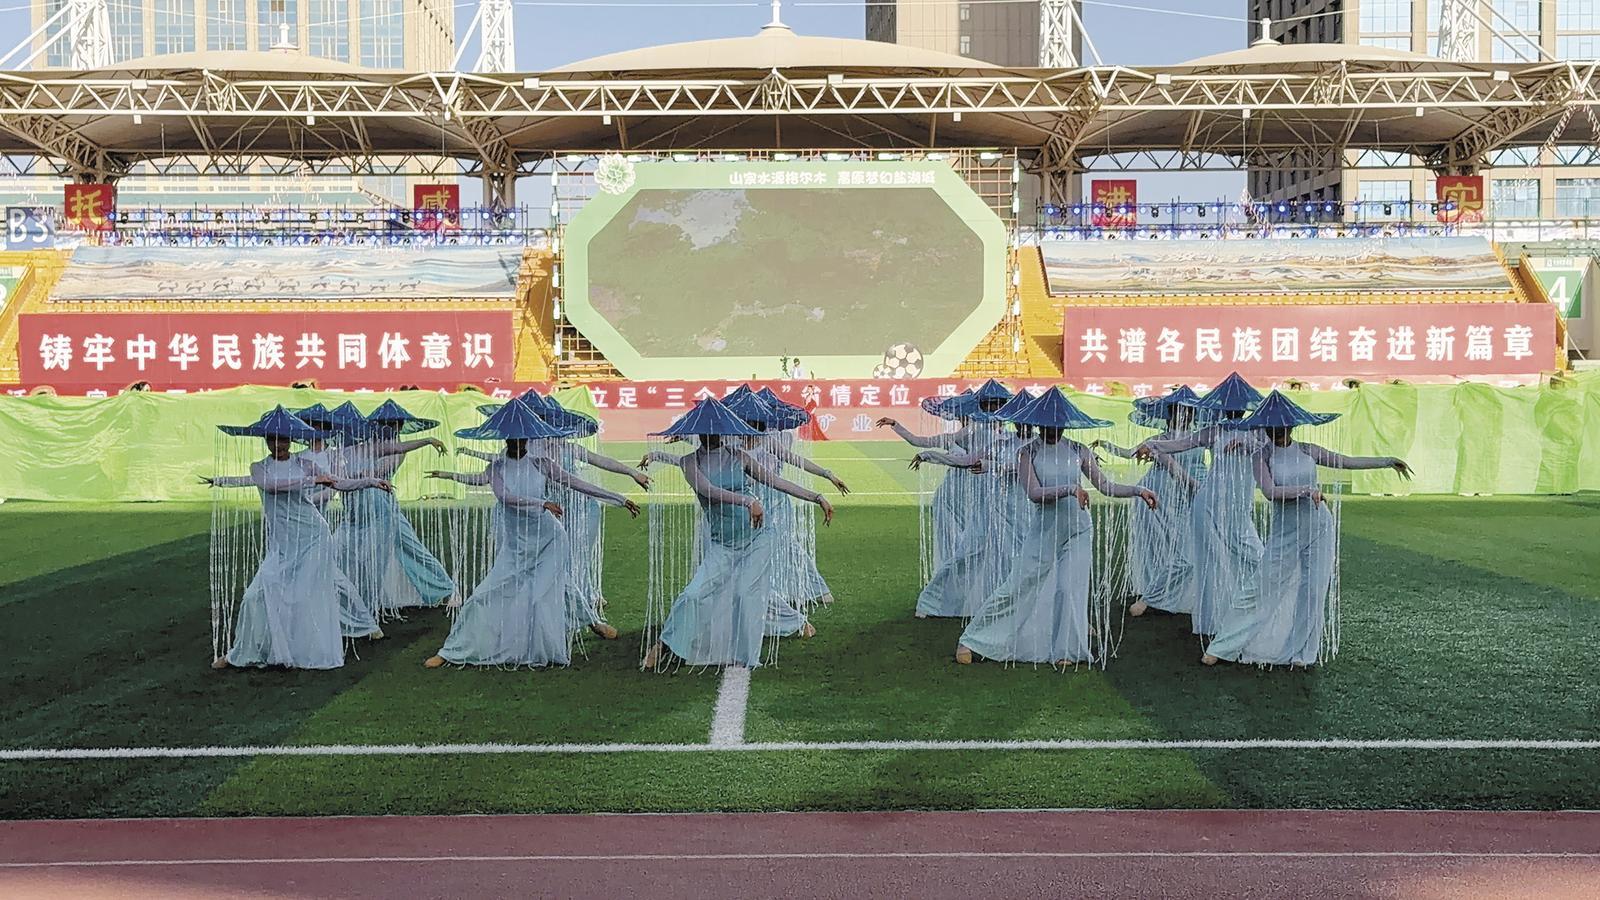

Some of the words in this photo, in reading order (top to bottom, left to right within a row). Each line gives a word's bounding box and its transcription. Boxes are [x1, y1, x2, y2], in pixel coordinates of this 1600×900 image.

[837, 170, 936, 185] 高原梦幻盐湖城
[9, 208, 49, 243] B3
[1548, 275, 1572, 313] 4
[39, 332, 496, 371] 铸牢中华民族共同体意识
[1079, 323, 1535, 365] 共谱各民族团结奋进新篇章
